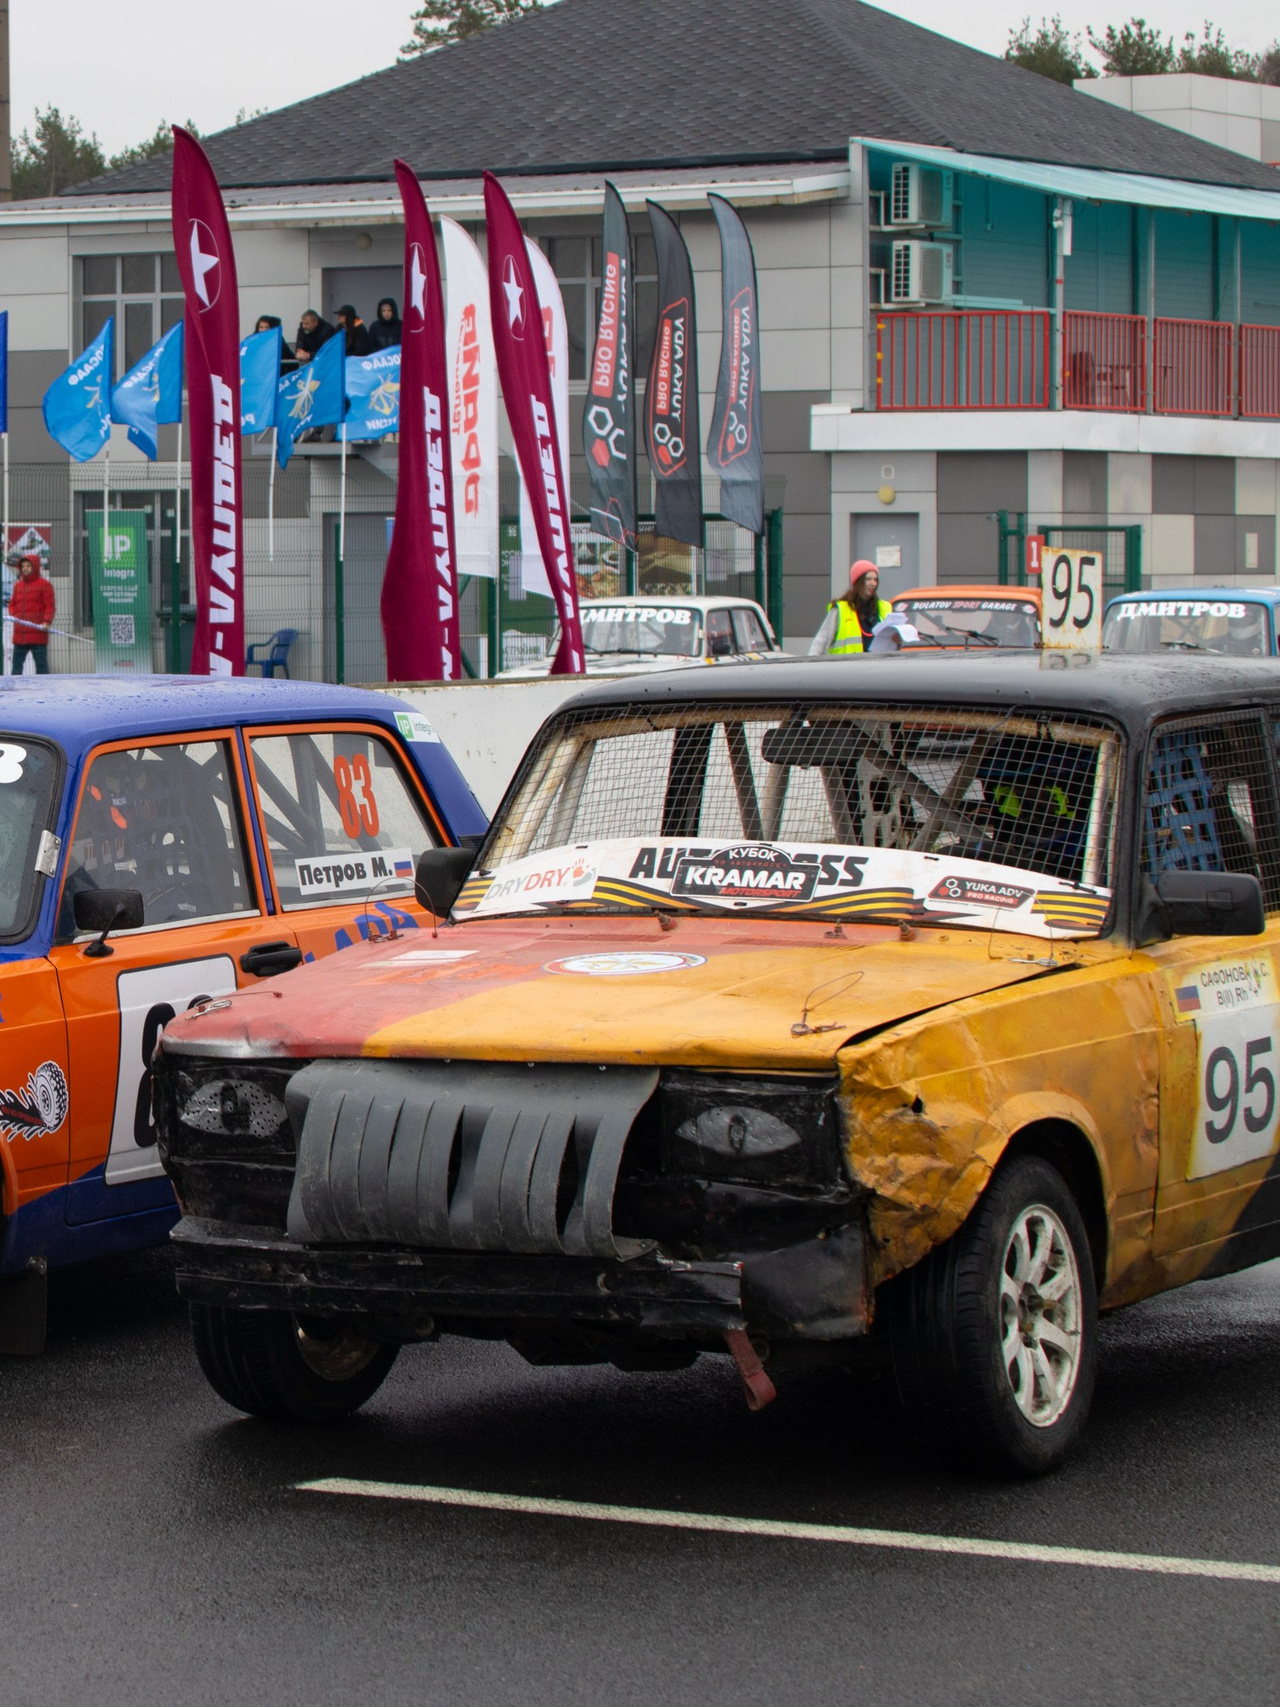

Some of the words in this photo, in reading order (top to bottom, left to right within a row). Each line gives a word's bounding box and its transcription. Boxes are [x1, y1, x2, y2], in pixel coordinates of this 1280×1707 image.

[1049, 554, 1096, 629] 95
[1117, 602, 1246, 620] ДМИТРОВ
[334, 753, 379, 840] 83
[729, 847, 779, 862] КУБОК
[298, 863, 367, 888] Петров
[371, 857, 393, 878] М.
[684, 867, 806, 890] KRAMAR
[719, 887, 802, 898] MOTORSPORT
[965, 881, 997, 893] YUKA
[998, 887, 1023, 898] ADV
[967, 891, 983, 900] PRO
[984, 894, 1014, 904] RACING
[1205, 1037, 1277, 1145] 95
